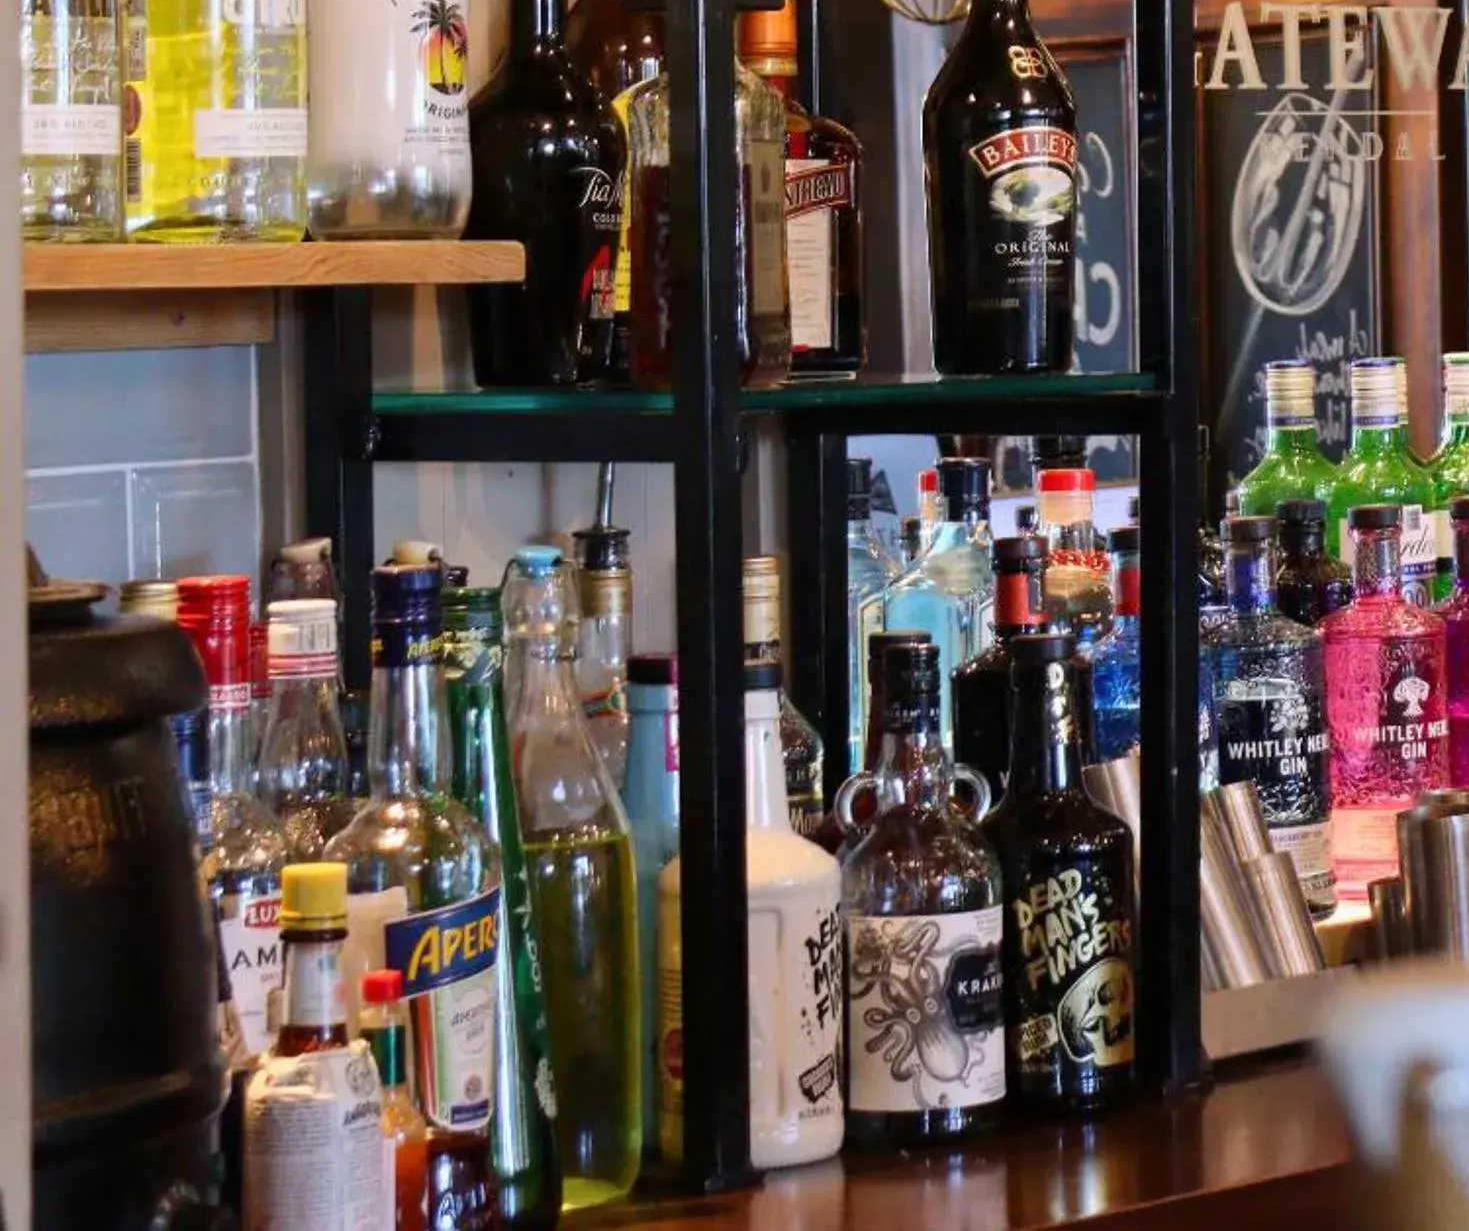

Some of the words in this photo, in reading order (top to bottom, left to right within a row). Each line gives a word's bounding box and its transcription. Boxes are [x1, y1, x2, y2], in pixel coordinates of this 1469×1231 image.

[994, 241, 1072, 255] ORIGINAL
[1354, 722, 1425, 743] WHITLEY
[1227, 739, 1304, 761] WHITLEY
[1401, 741, 1428, 760] GIN
[1279, 756, 1309, 777] GIN
[1013, 869, 1082, 929] DEAD
[1026, 919, 1132, 992] FINGERS
